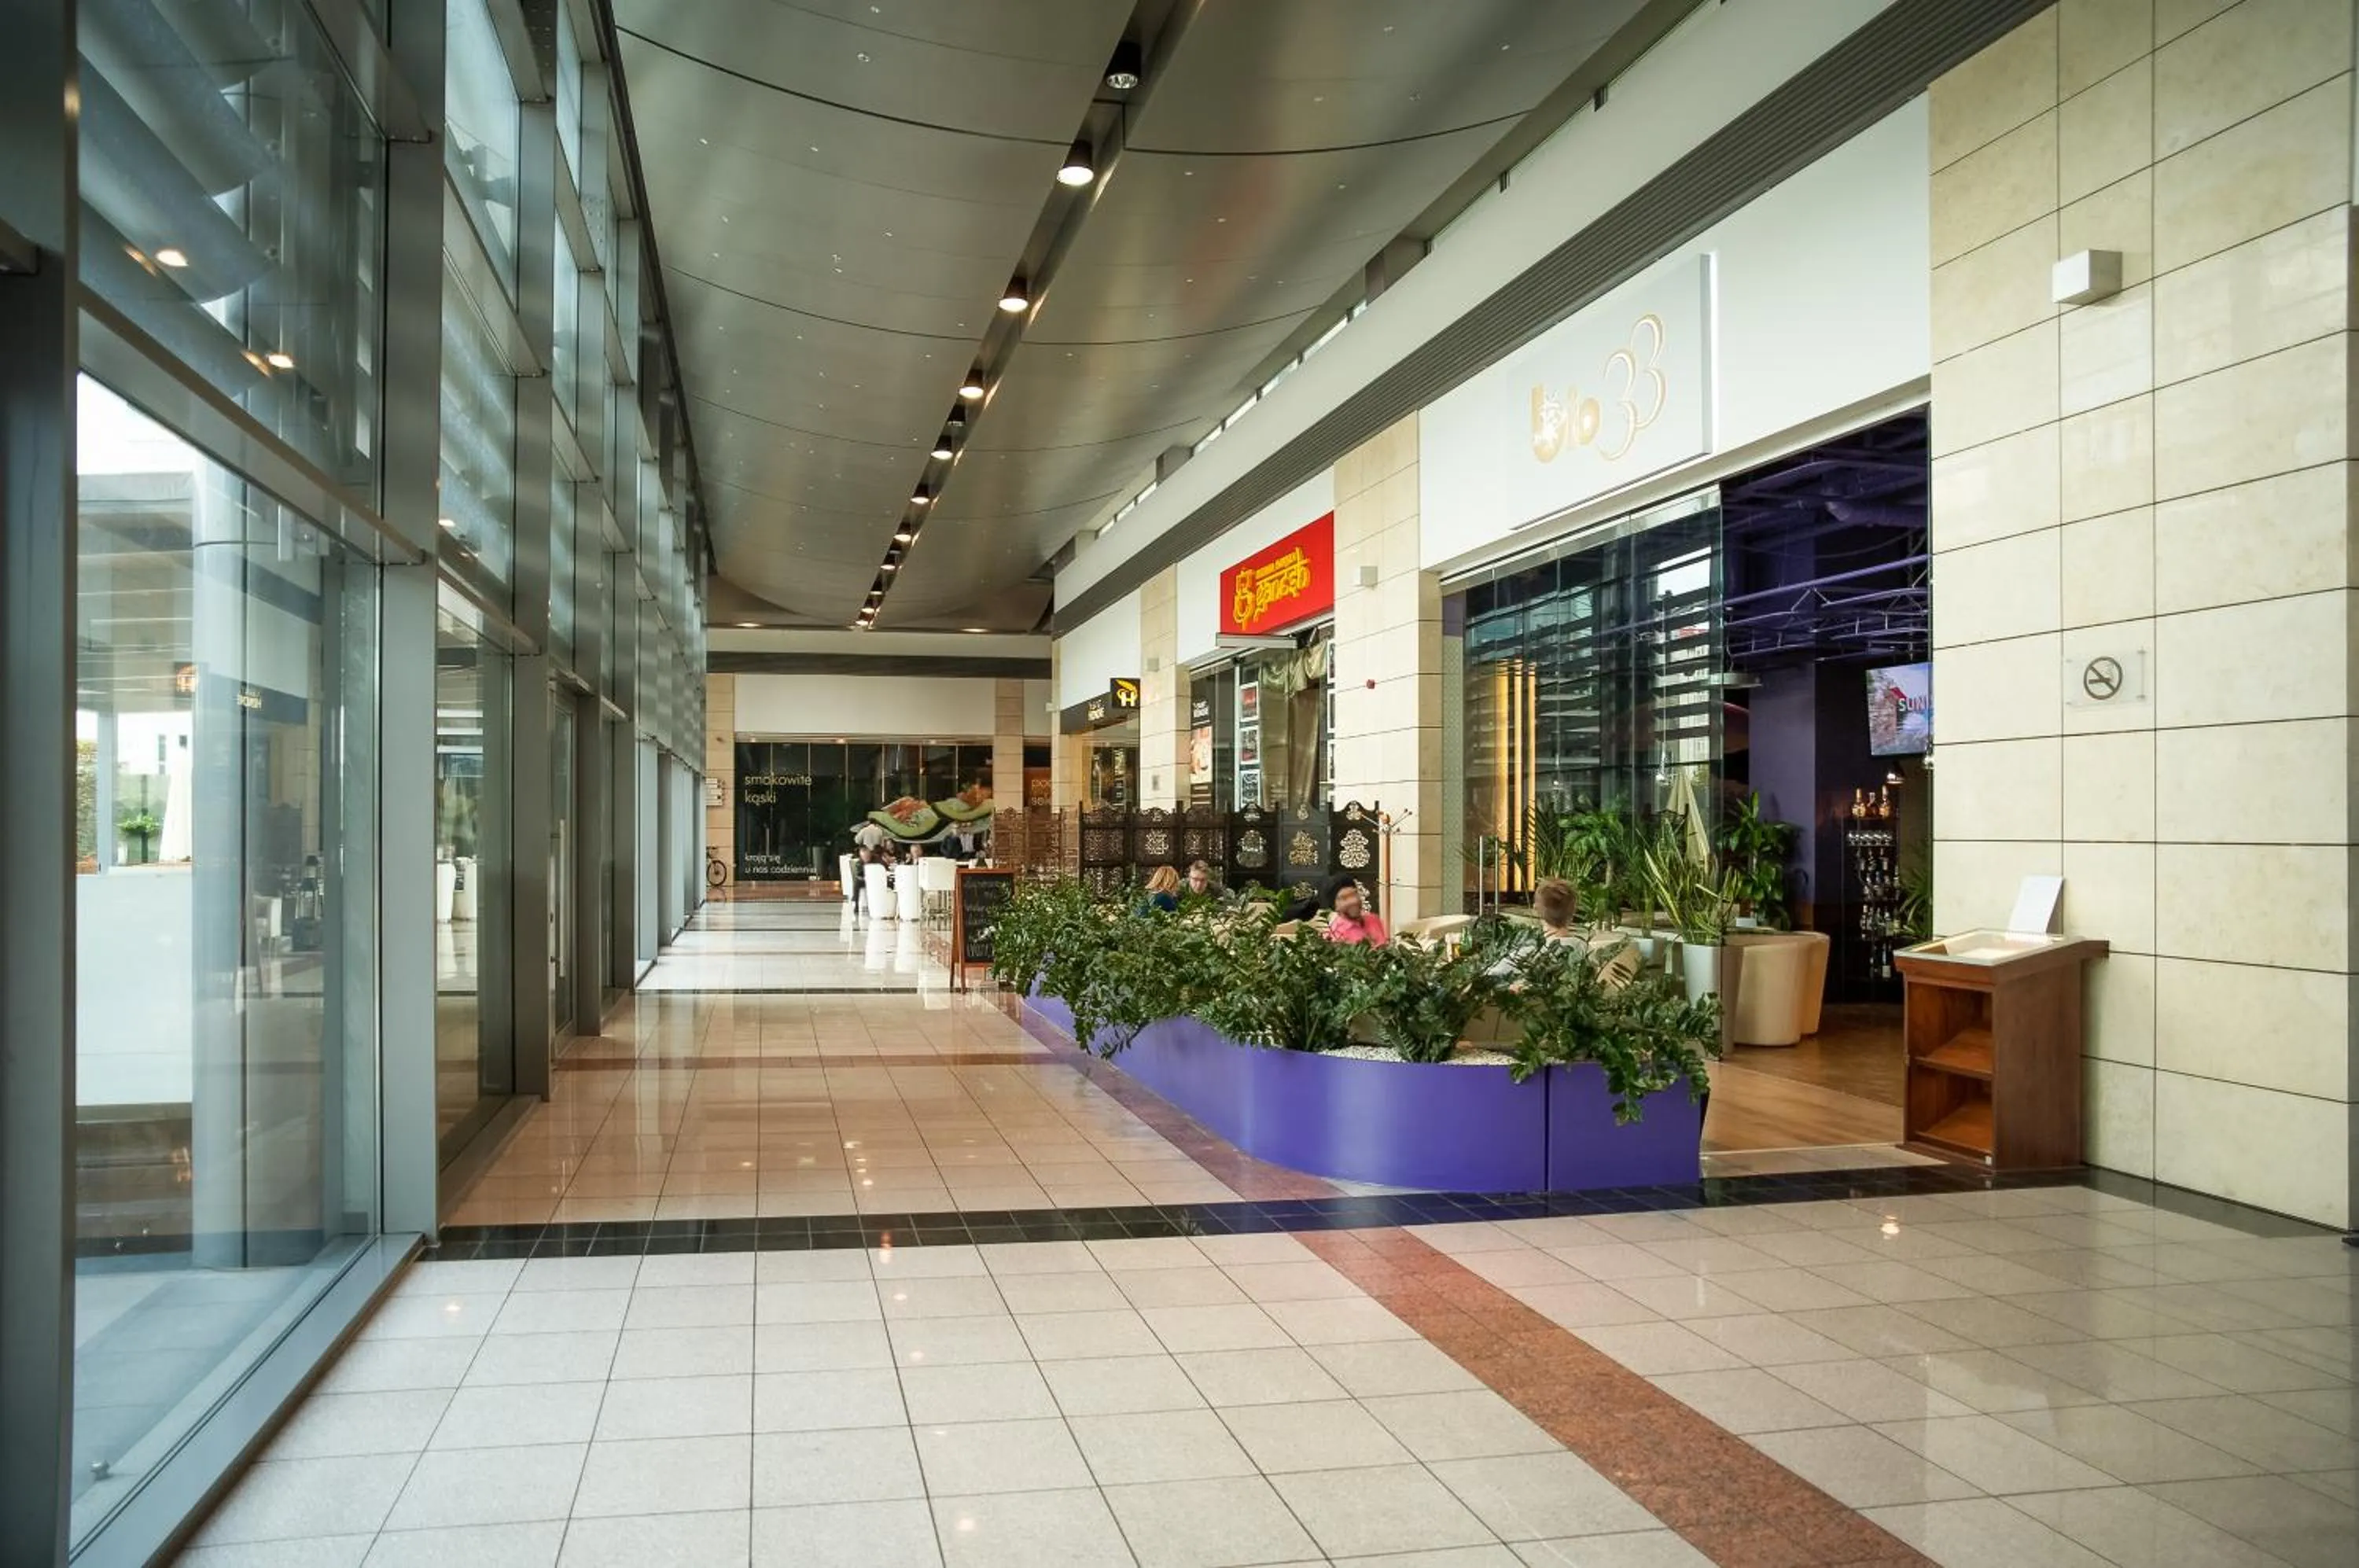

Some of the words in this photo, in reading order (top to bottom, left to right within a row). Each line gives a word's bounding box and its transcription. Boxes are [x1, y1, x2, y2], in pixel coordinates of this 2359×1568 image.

[1898, 695, 1929, 712] SUN
[744, 772, 812, 786] smakowite
[744, 789, 776, 806] kąski
